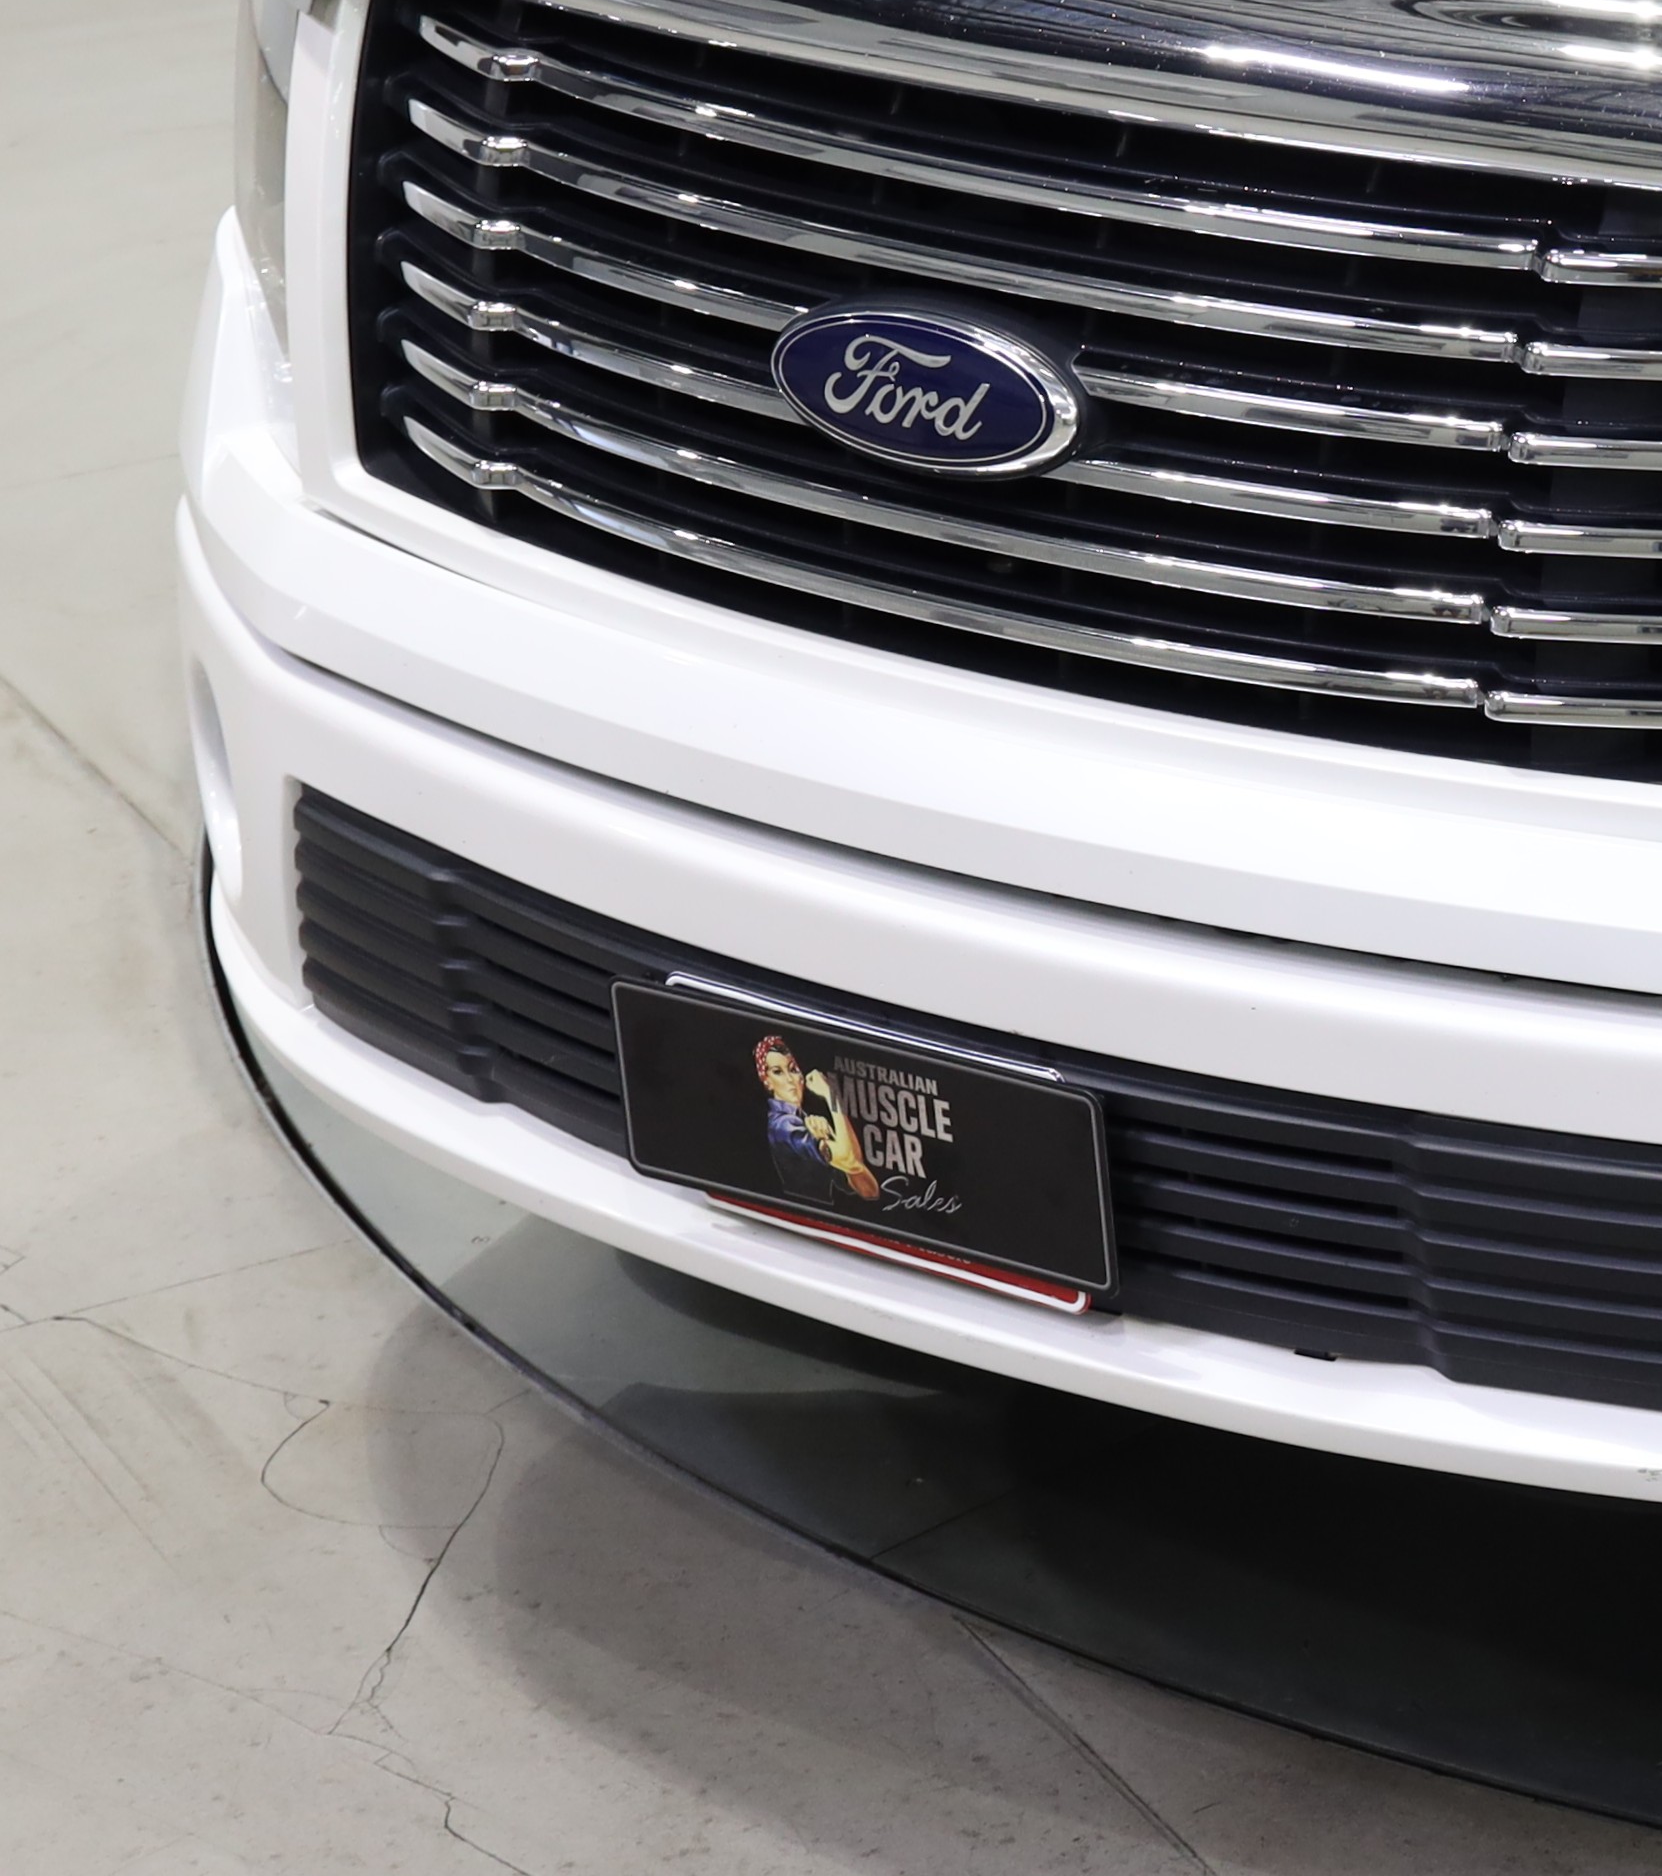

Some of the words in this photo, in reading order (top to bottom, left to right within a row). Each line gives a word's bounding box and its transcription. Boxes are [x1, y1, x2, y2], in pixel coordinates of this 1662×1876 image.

[824, 334, 990, 440] Ford
[833, 1055, 939, 1097] AUSTRALIAN
[830, 1073, 954, 1144] MUSCLE
[864, 1123, 927, 1179] CAR
[880, 1176, 962, 1215] Sales
